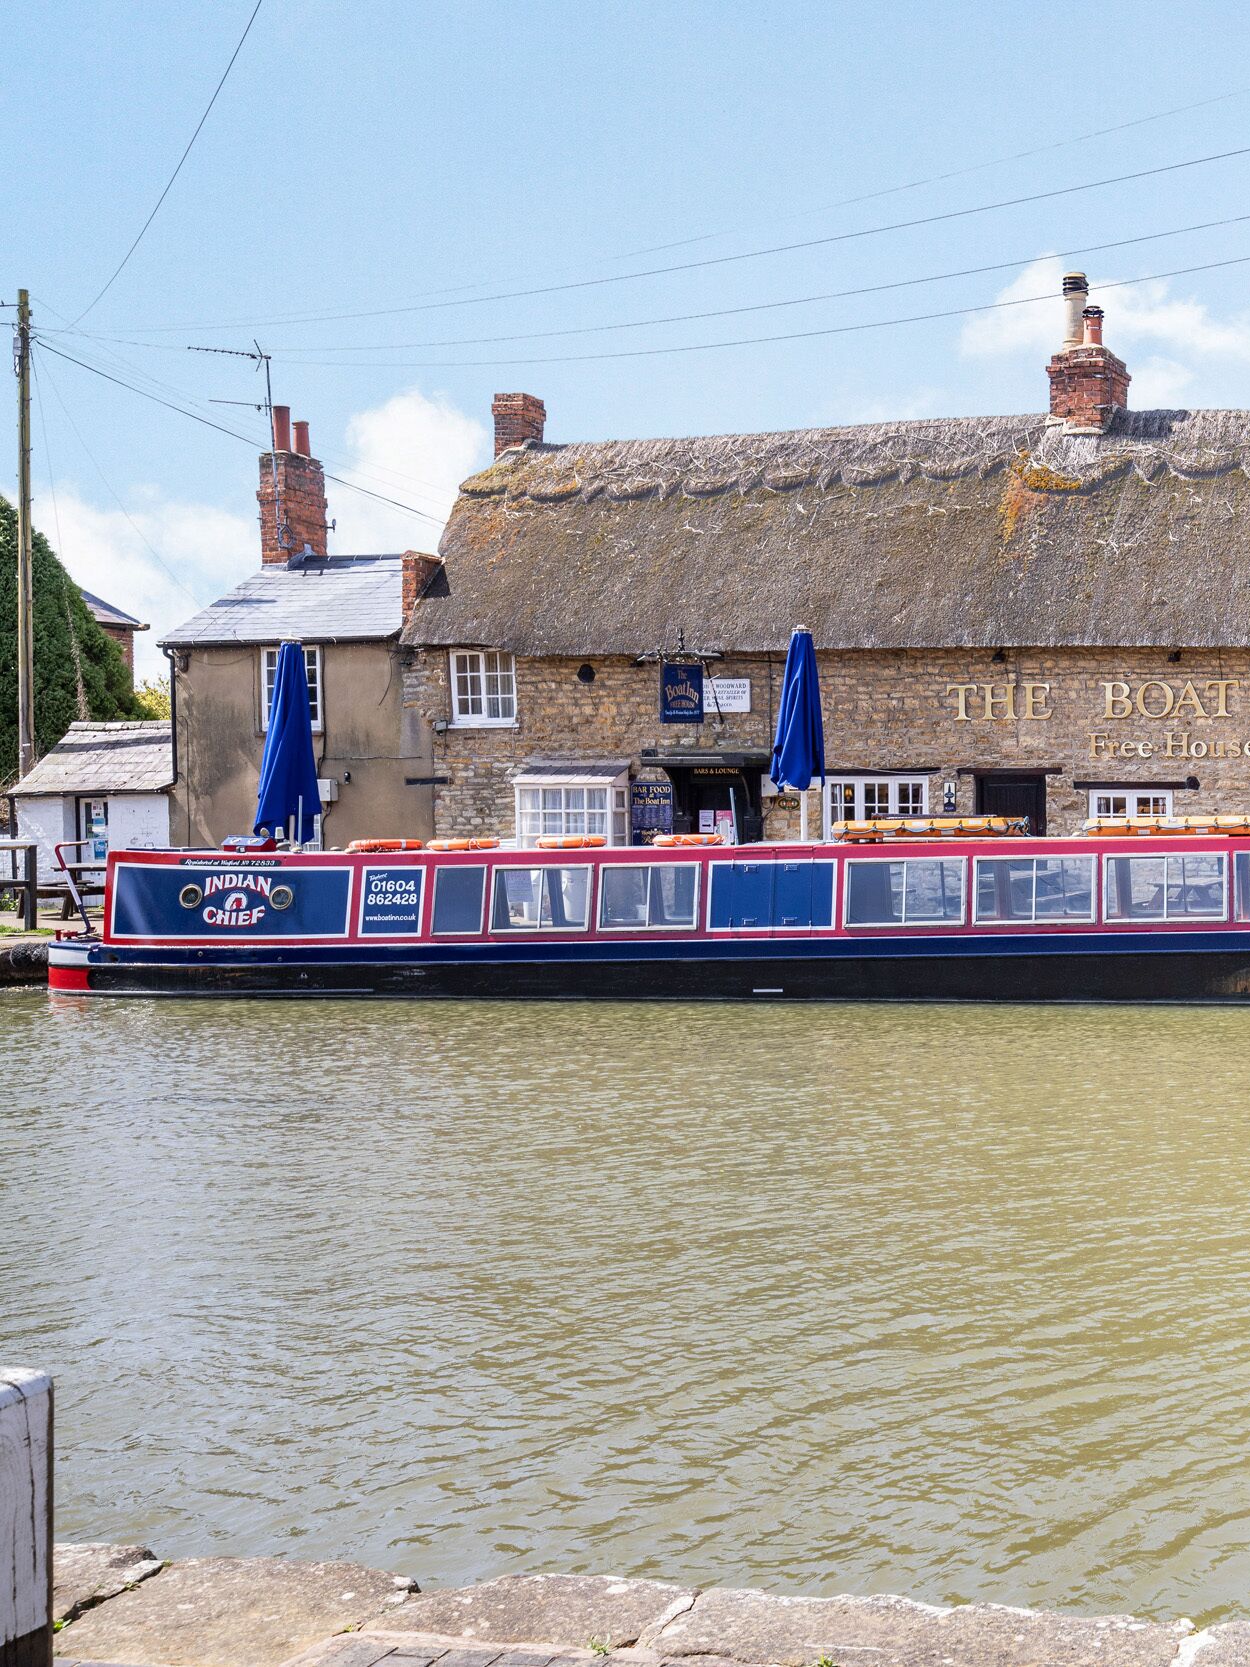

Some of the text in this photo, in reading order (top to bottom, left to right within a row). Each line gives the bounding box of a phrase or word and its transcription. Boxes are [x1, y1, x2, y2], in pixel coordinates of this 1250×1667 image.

[665, 681, 700, 705] Boat Inn
[946, 682, 1053, 721] THE
[1101, 679, 1240, 719] BOAT
[1087, 731, 1154, 760] Free
[634, 797, 671, 805] The Boat Inn
[184, 859, 213, 867] Registered
[203, 873, 272, 898] INDIAN
[371, 880, 415, 892] 01604
[367, 893, 417, 905] 862428
[202, 905, 266, 927] CHIEF
[365, 912, 416, 921] www.boatinn.co.uk
